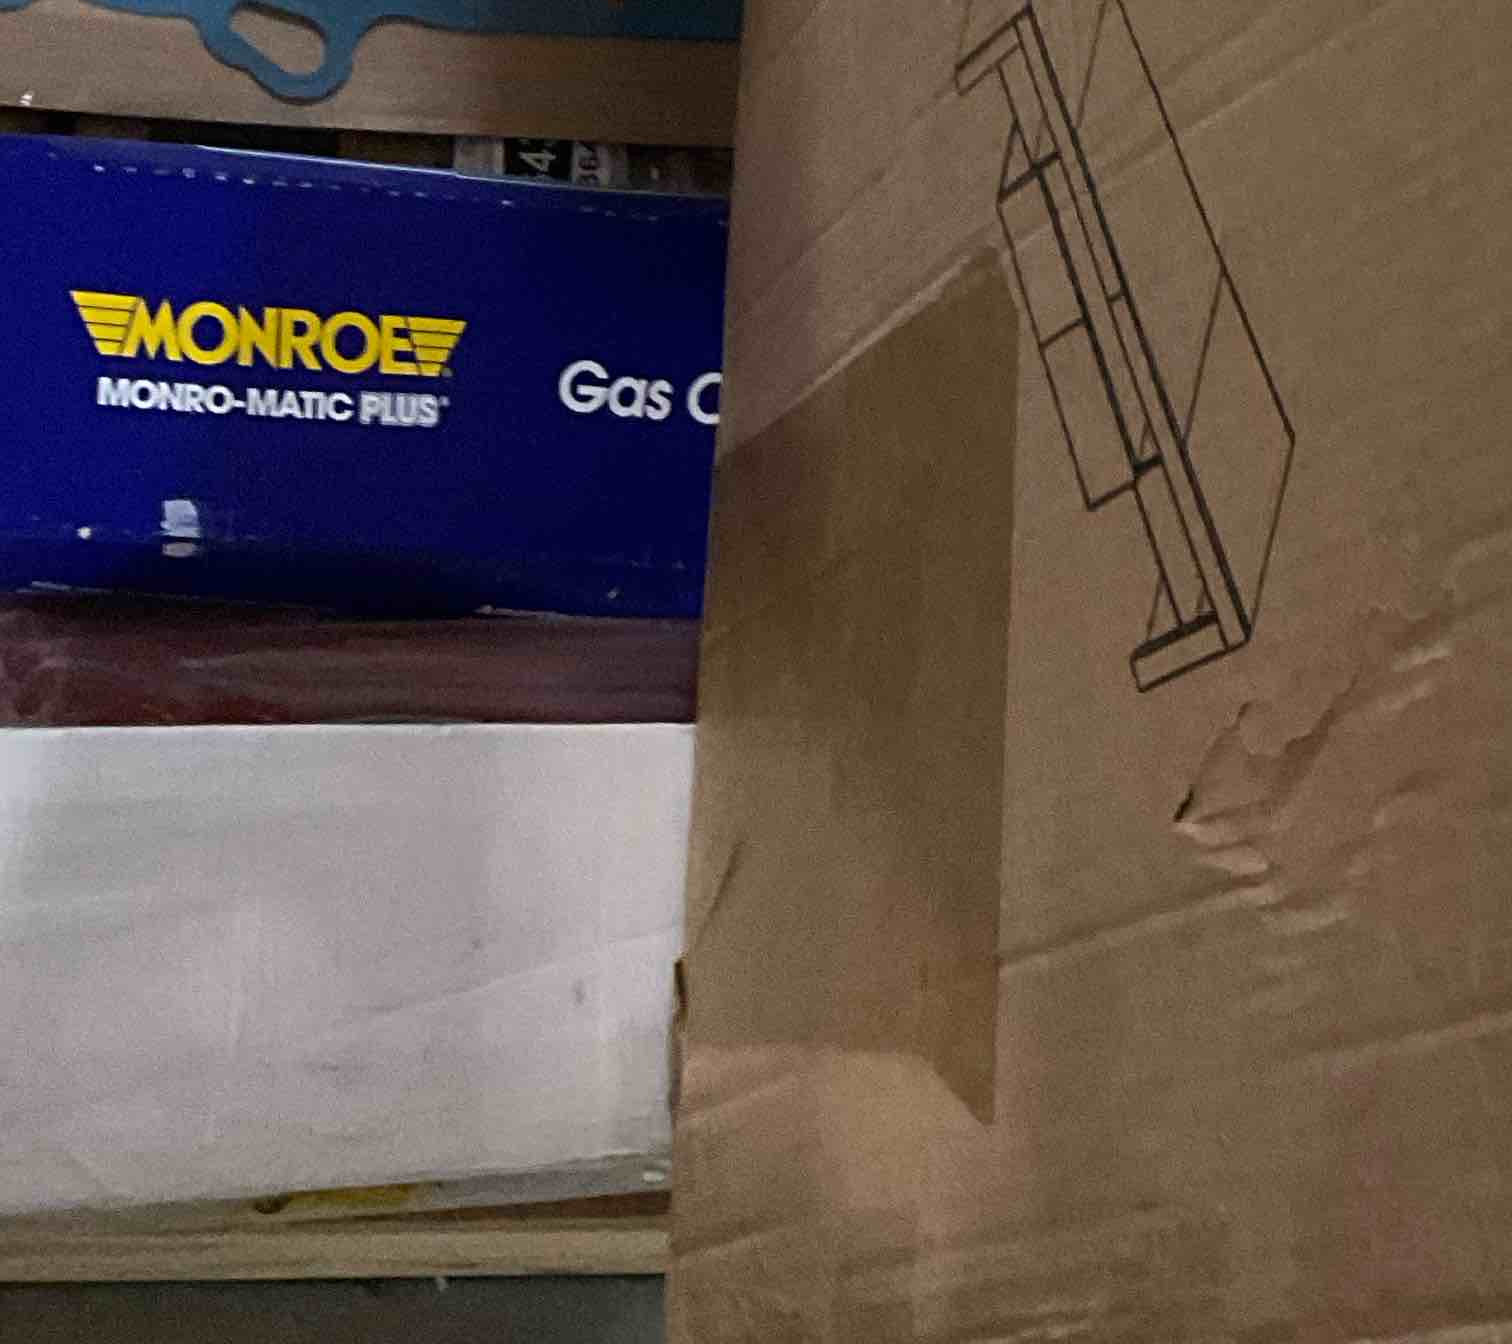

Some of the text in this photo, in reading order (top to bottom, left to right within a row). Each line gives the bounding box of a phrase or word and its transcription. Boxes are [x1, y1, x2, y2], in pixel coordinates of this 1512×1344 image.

[118, 296, 424, 377] MONROE
[96, 376, 354, 424] MONRO-MATIC
[557, 358, 674, 422] Gas
